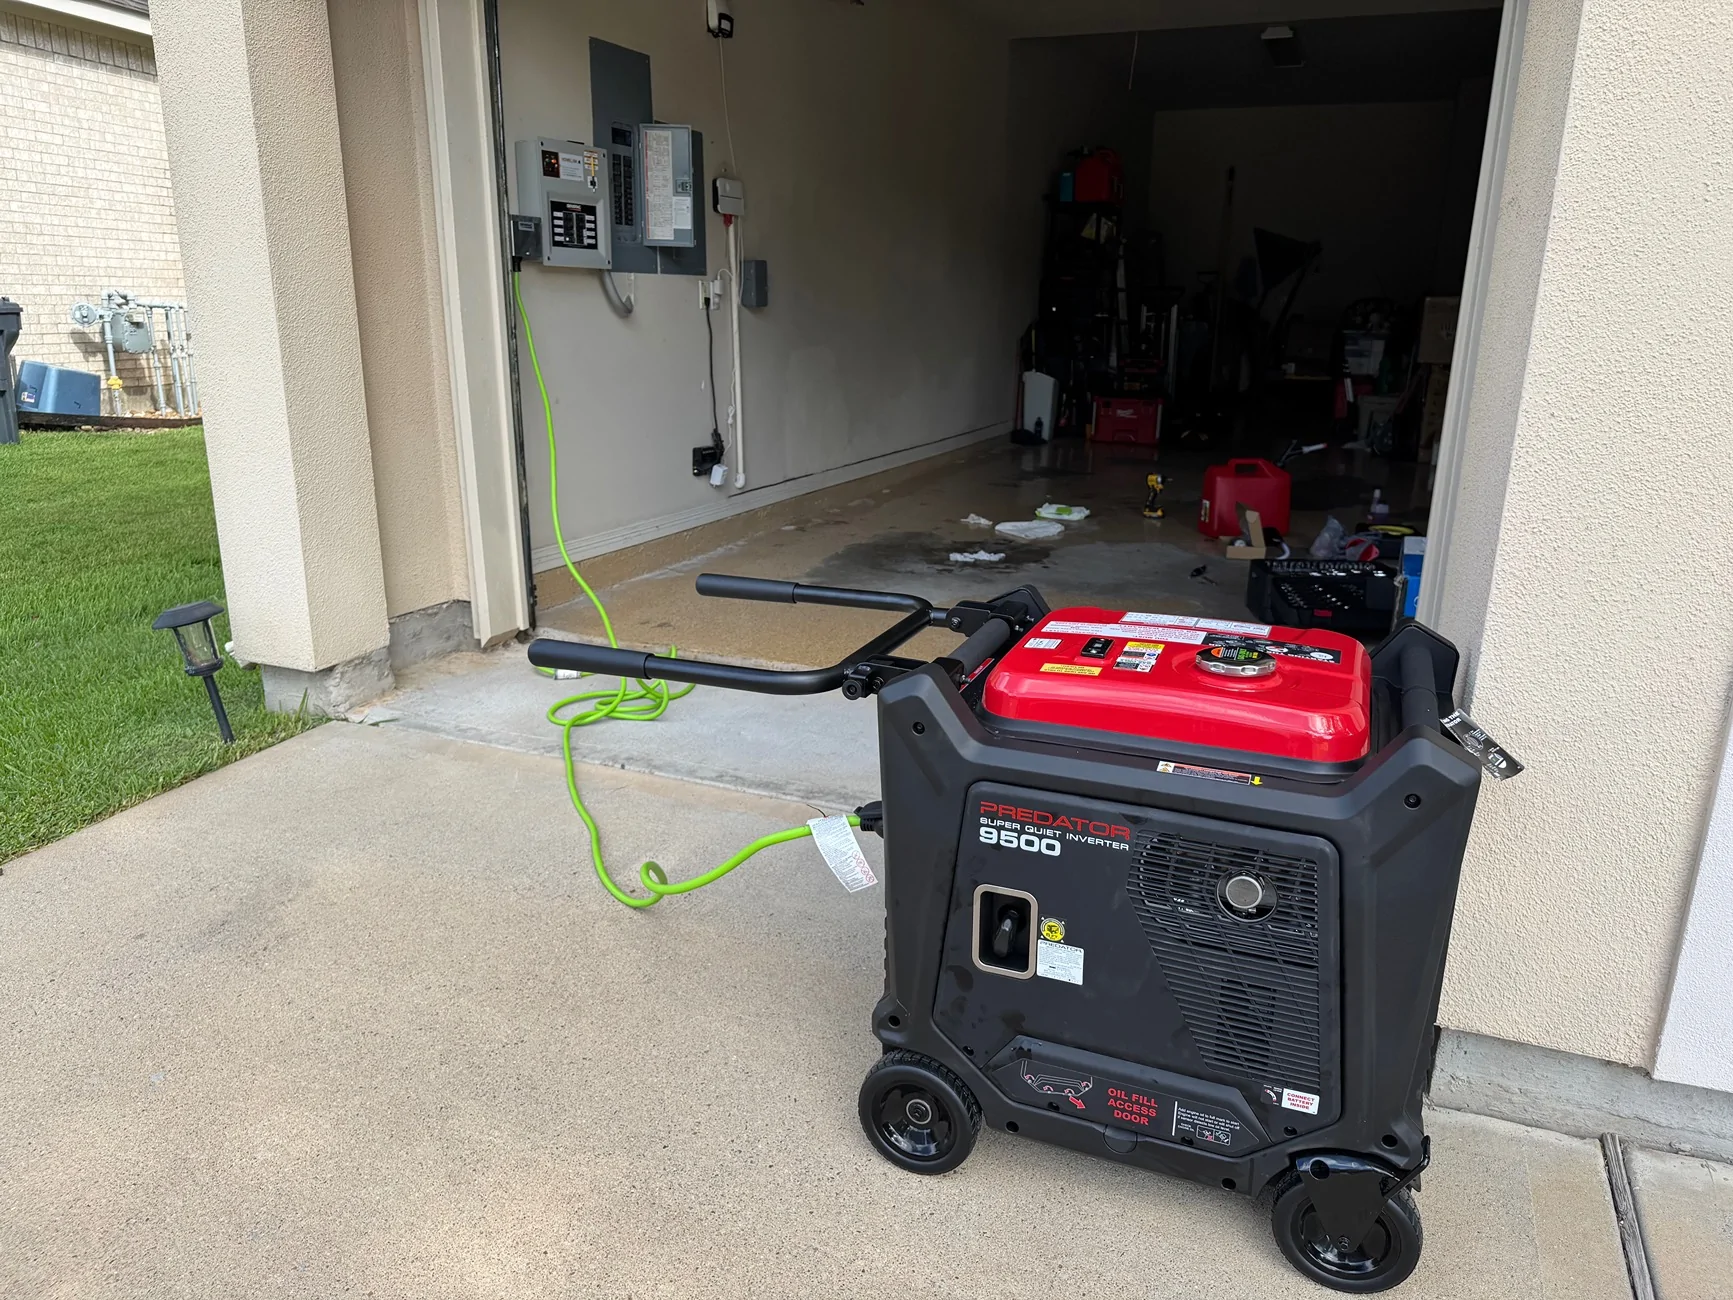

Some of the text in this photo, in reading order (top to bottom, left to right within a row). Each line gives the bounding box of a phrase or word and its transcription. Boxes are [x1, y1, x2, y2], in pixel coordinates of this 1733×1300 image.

[980, 801, 1131, 840] PREDATOR
[979, 817, 1130, 851] SUPER QUIET INVERTER
[979, 826, 1061, 856] 9500
[1107, 1088, 1158, 1107] OIL FILL
[1286, 1092, 1315, 1102] CONNECT
[1287, 1097, 1314, 1106] BATTERY
[1289, 1102, 1310, 1110] INSIDE
[1107, 1098, 1157, 1117] ACCESS
[1113, 1109, 1149, 1126] DOOR
